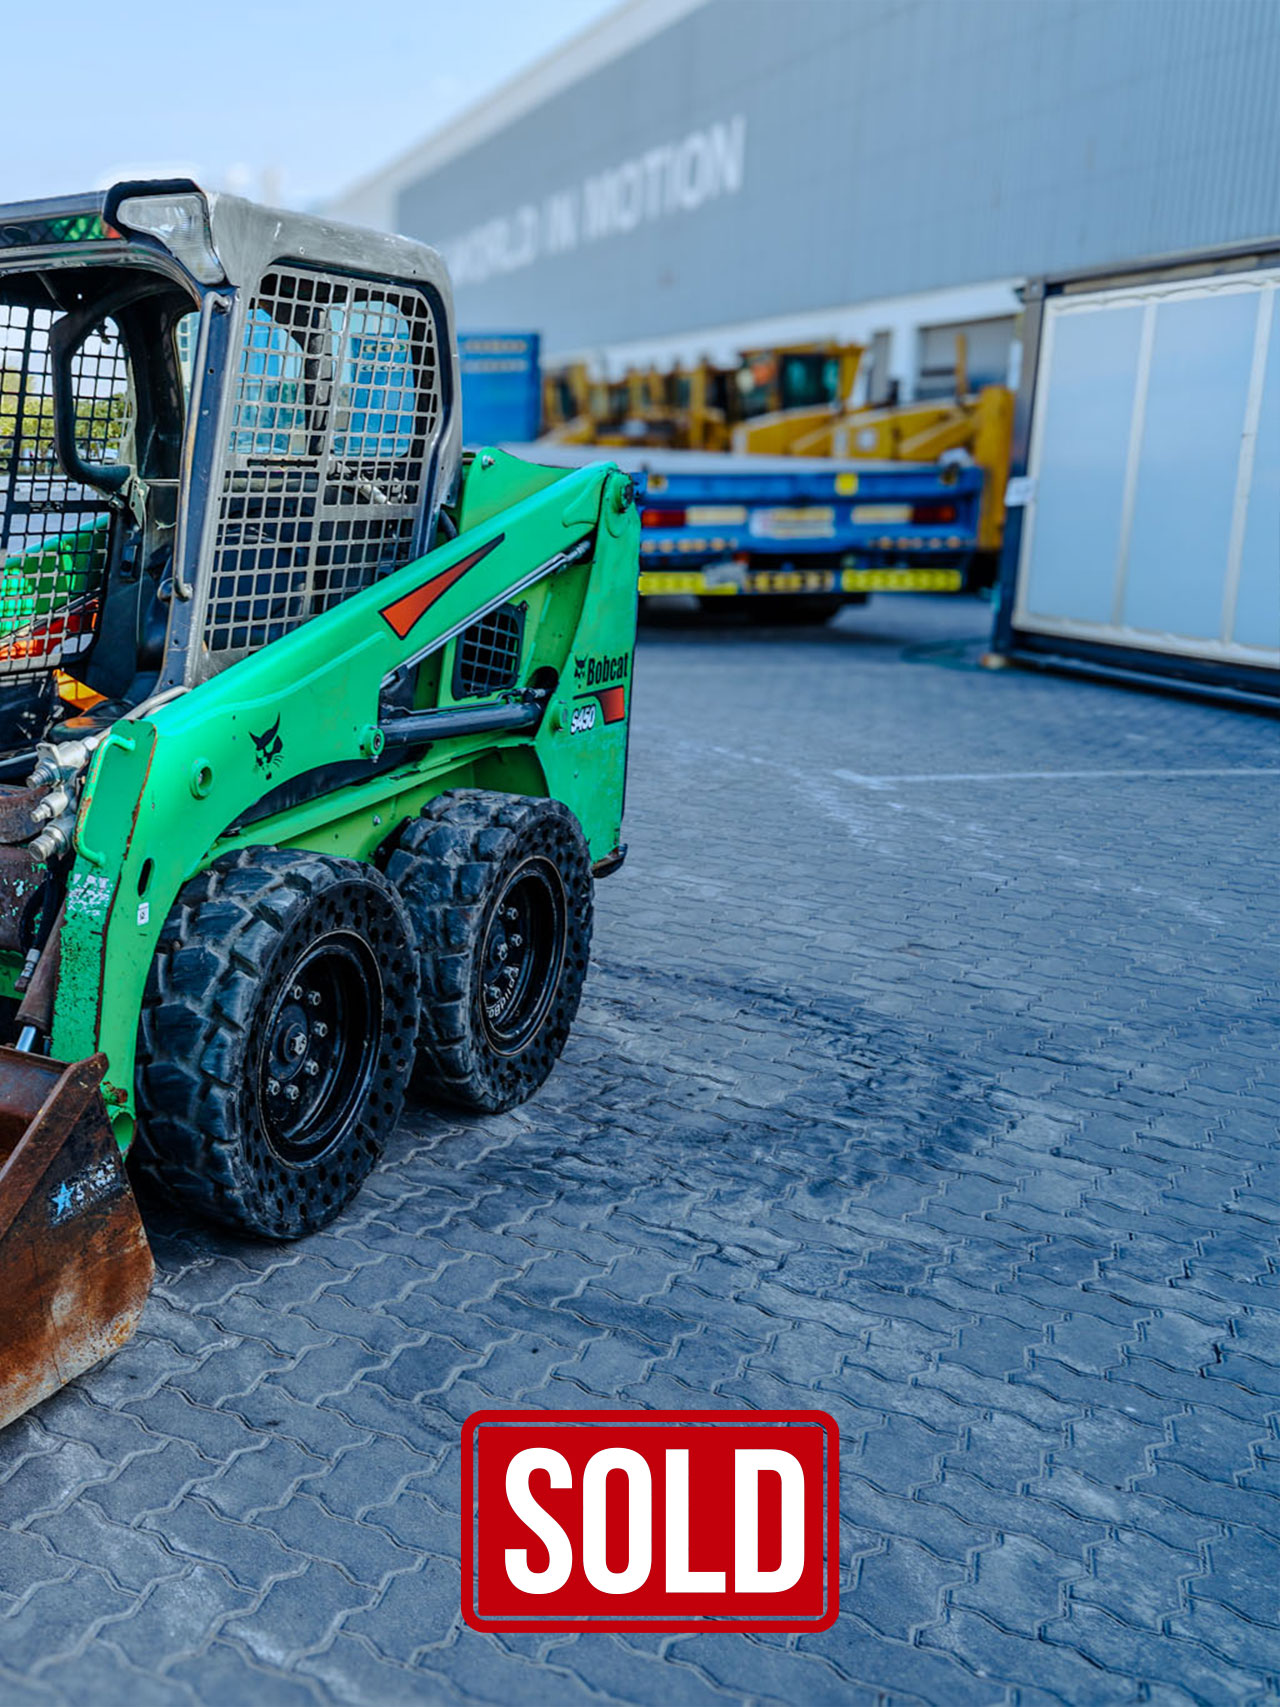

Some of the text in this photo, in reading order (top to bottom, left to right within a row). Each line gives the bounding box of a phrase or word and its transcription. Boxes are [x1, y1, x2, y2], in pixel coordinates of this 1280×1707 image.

[583, 114, 746, 240] MOTION
[587, 652, 629, 686] Bobcat
[570, 703, 596, 735] S450
